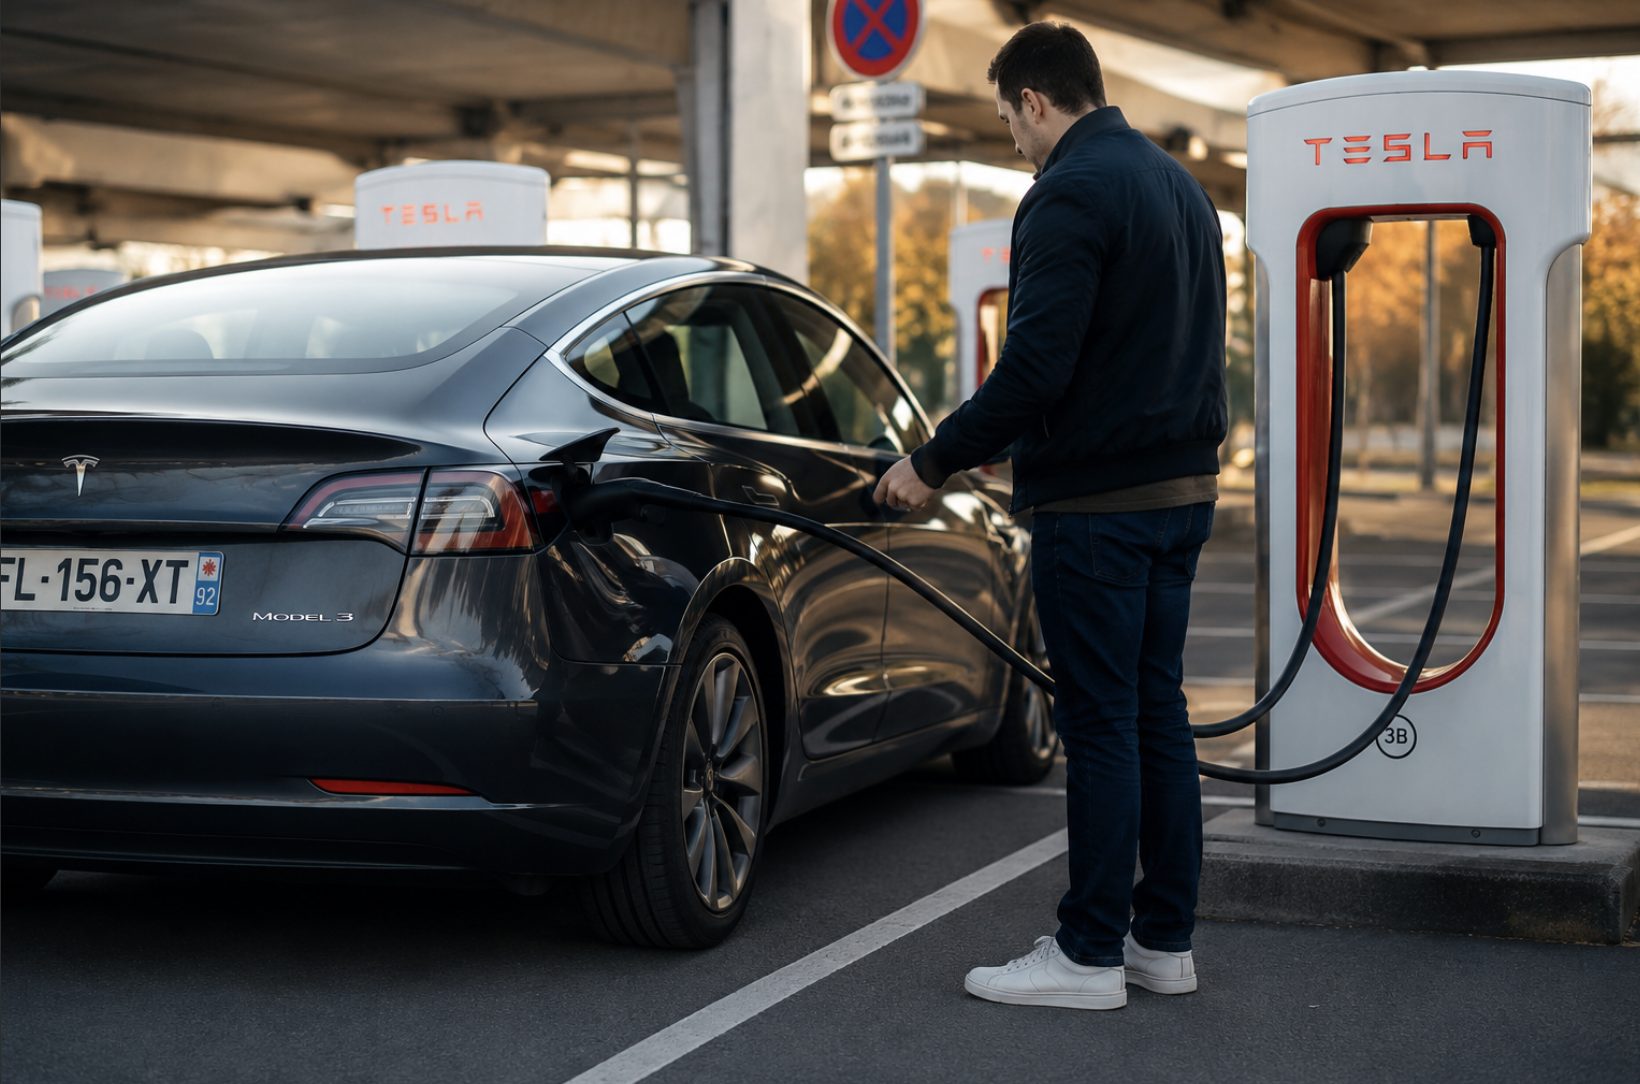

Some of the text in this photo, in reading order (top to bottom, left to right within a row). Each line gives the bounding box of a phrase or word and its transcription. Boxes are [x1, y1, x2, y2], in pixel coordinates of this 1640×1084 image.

[1304, 130, 1492, 165] TESLA
[379, 201, 484, 225] TESLA
[195, 587, 216, 606] 92
[252, 612, 354, 622] MODEL 3
[1384, 727, 1408, 744] 3B
